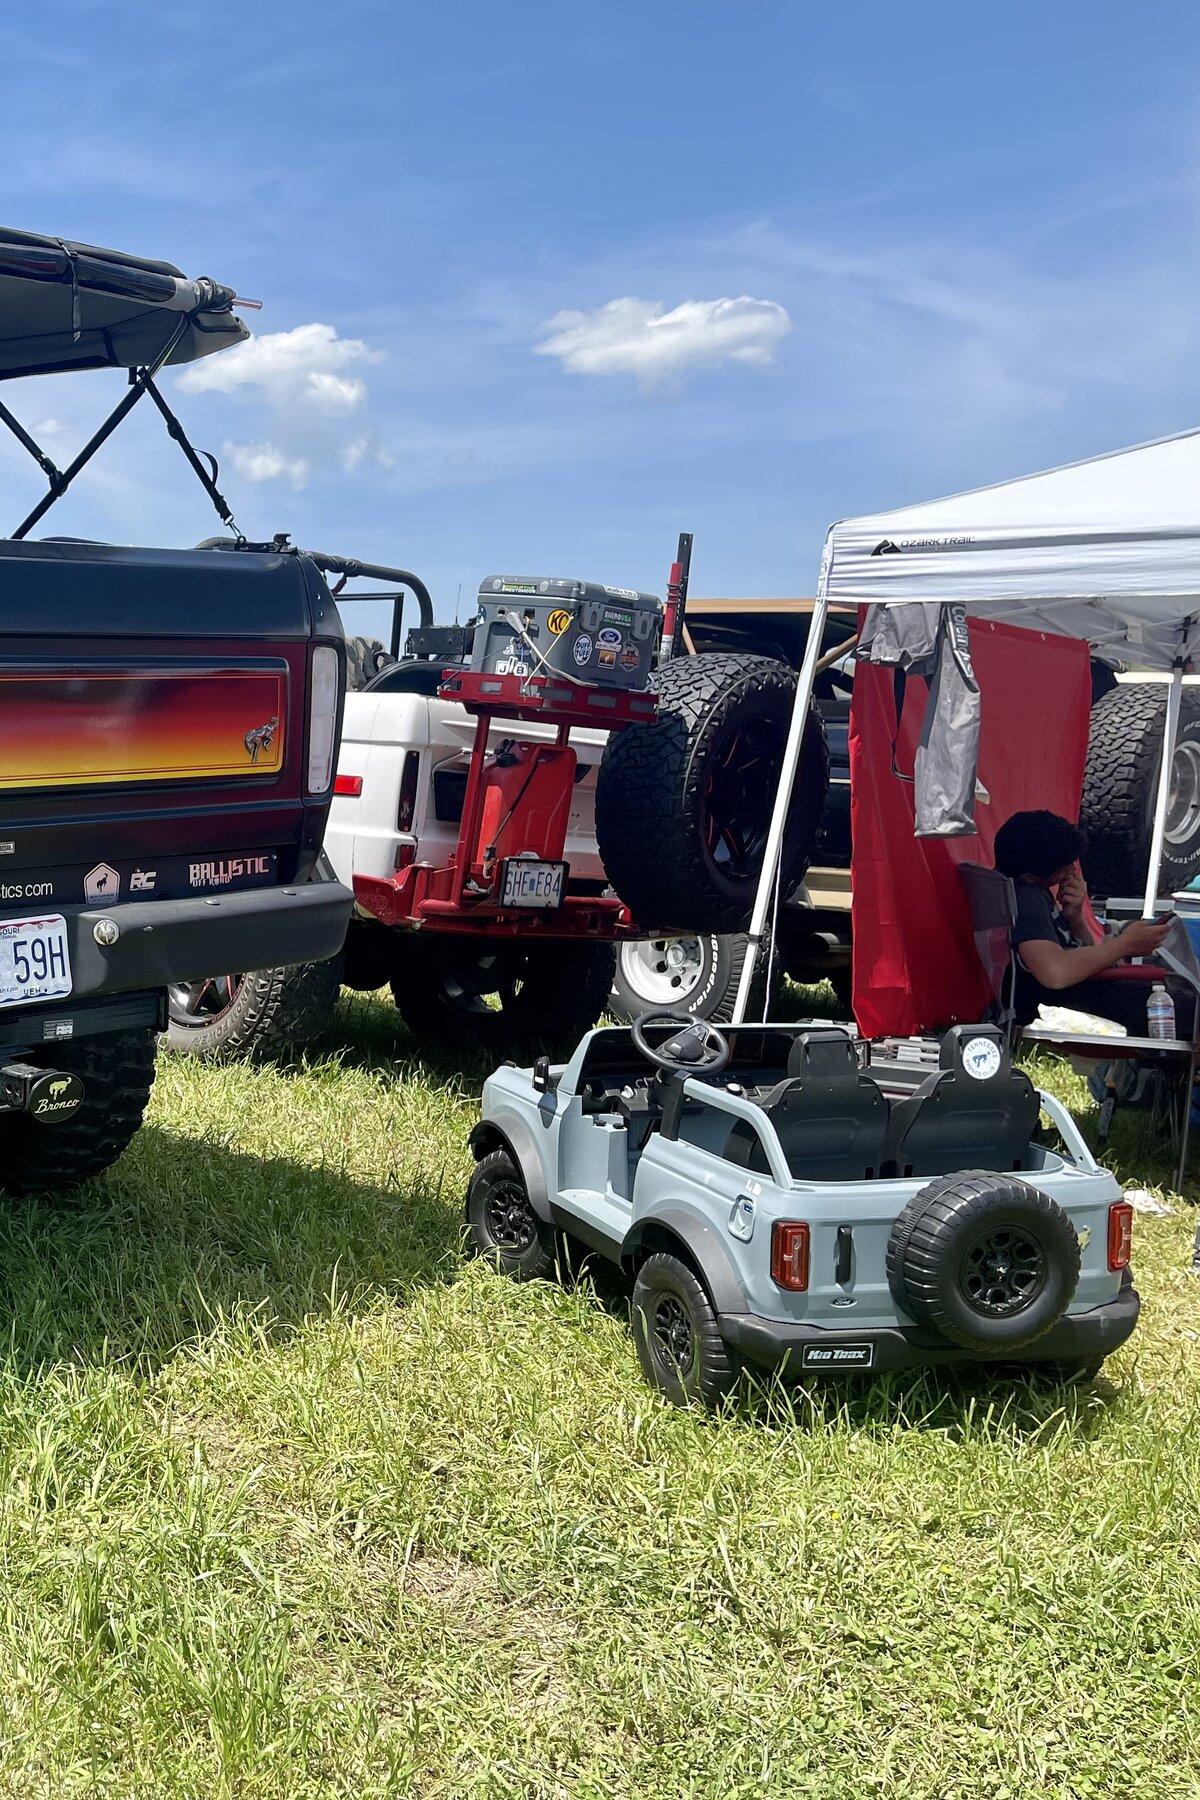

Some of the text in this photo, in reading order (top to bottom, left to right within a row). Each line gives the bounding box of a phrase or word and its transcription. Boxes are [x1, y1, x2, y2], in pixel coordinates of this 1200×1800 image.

[901, 536, 976, 548] OZARK TRAIL
[550, 611, 569, 632] KC
[189, 856, 269, 885] BALLISTIC
[130, 871, 157, 892] RC
[13, 935, 67, 984] 59H
[23, 988, 42, 996] VEH
[34, 1098, 80, 1115] Bronco
[807, 1349, 832, 1360] KID
